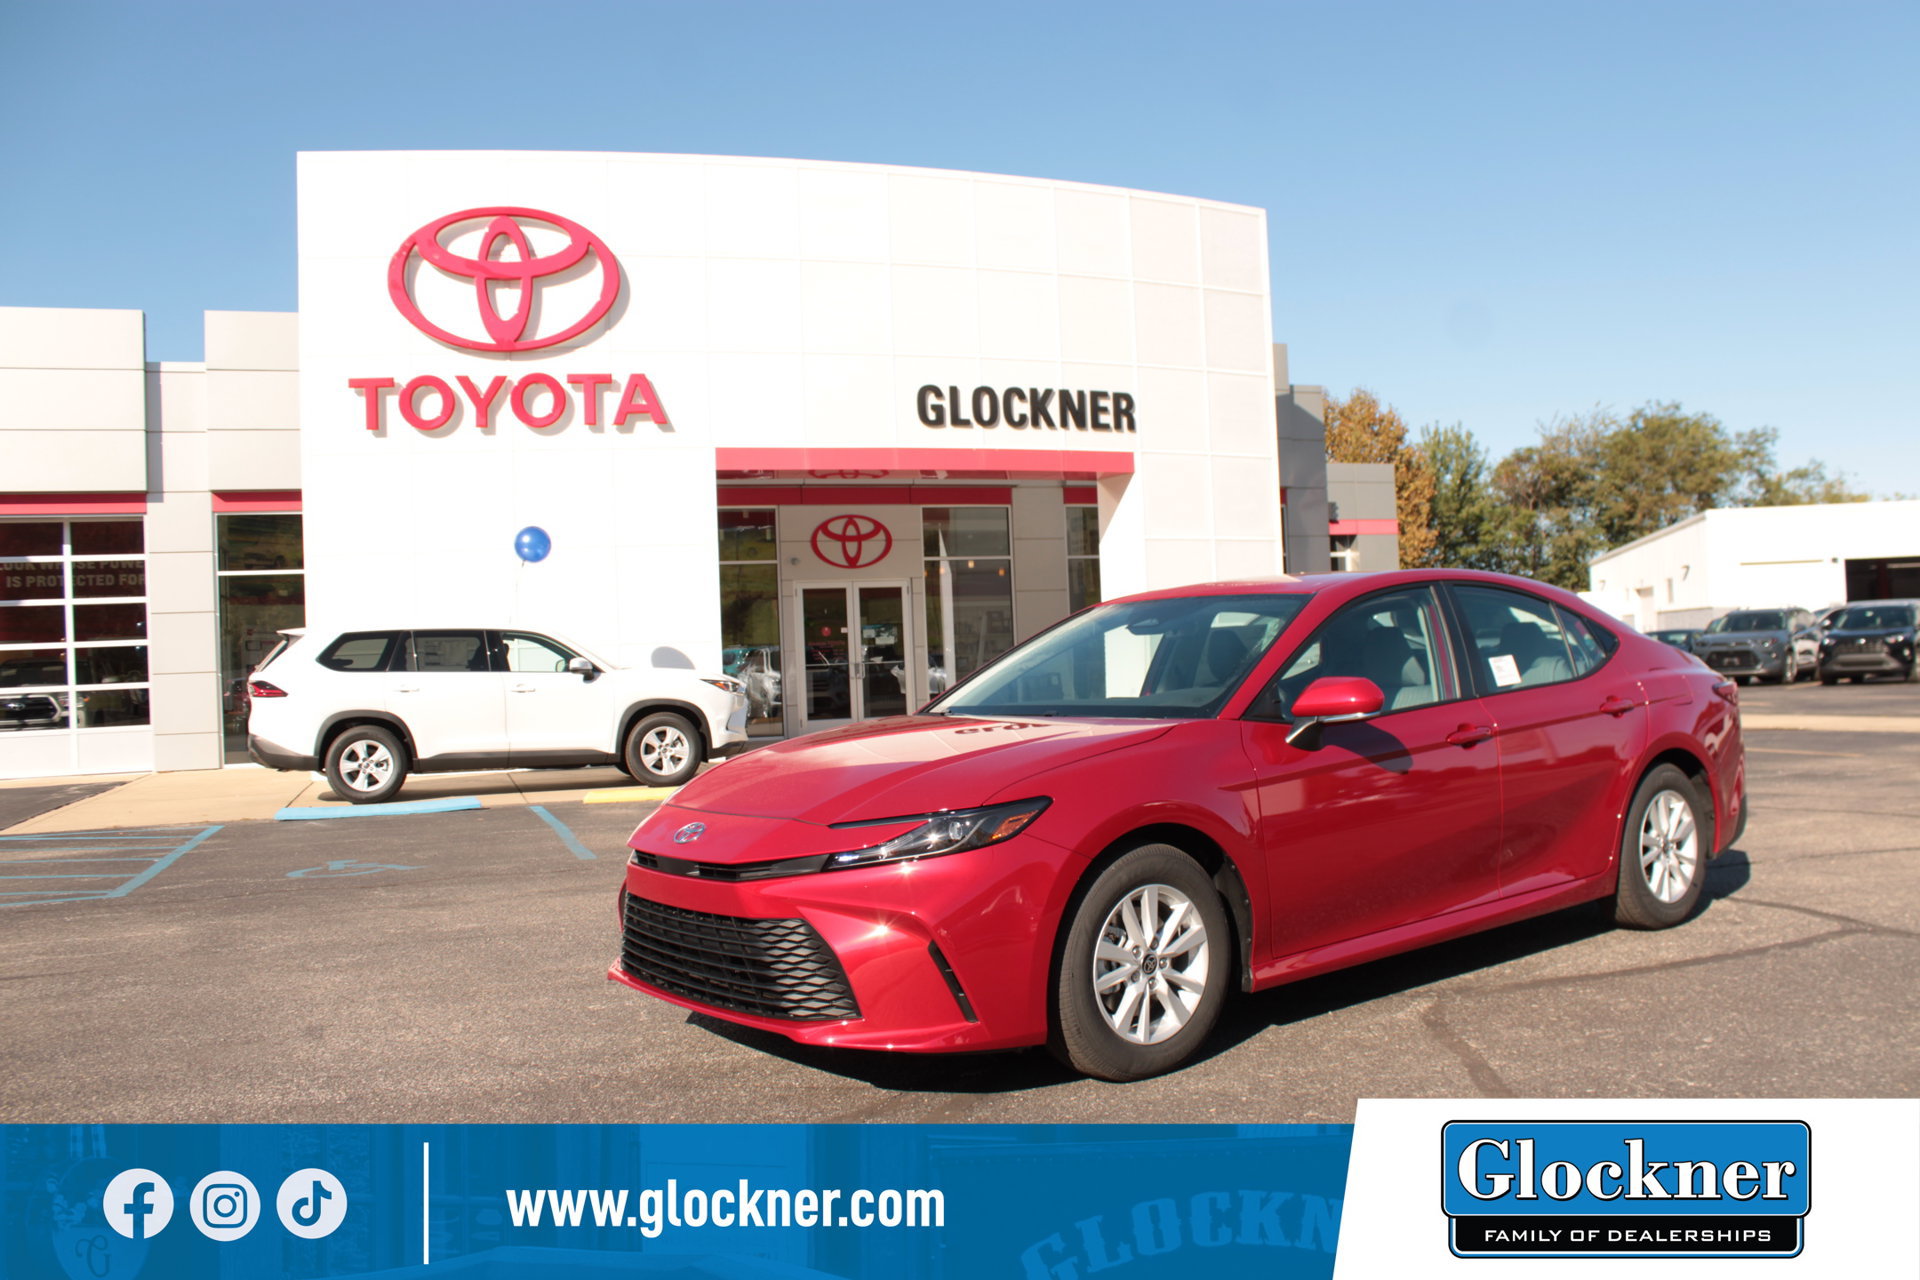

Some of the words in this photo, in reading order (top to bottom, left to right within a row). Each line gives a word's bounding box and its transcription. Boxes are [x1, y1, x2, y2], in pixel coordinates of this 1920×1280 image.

[348, 372, 670, 432] TOYOTA
[917, 384, 1136, 432] GLOCKNER
[6, 574, 23, 588] IS
[26, 574, 115, 588] PROTCTED
[40, 562, 96, 570] WHSE
